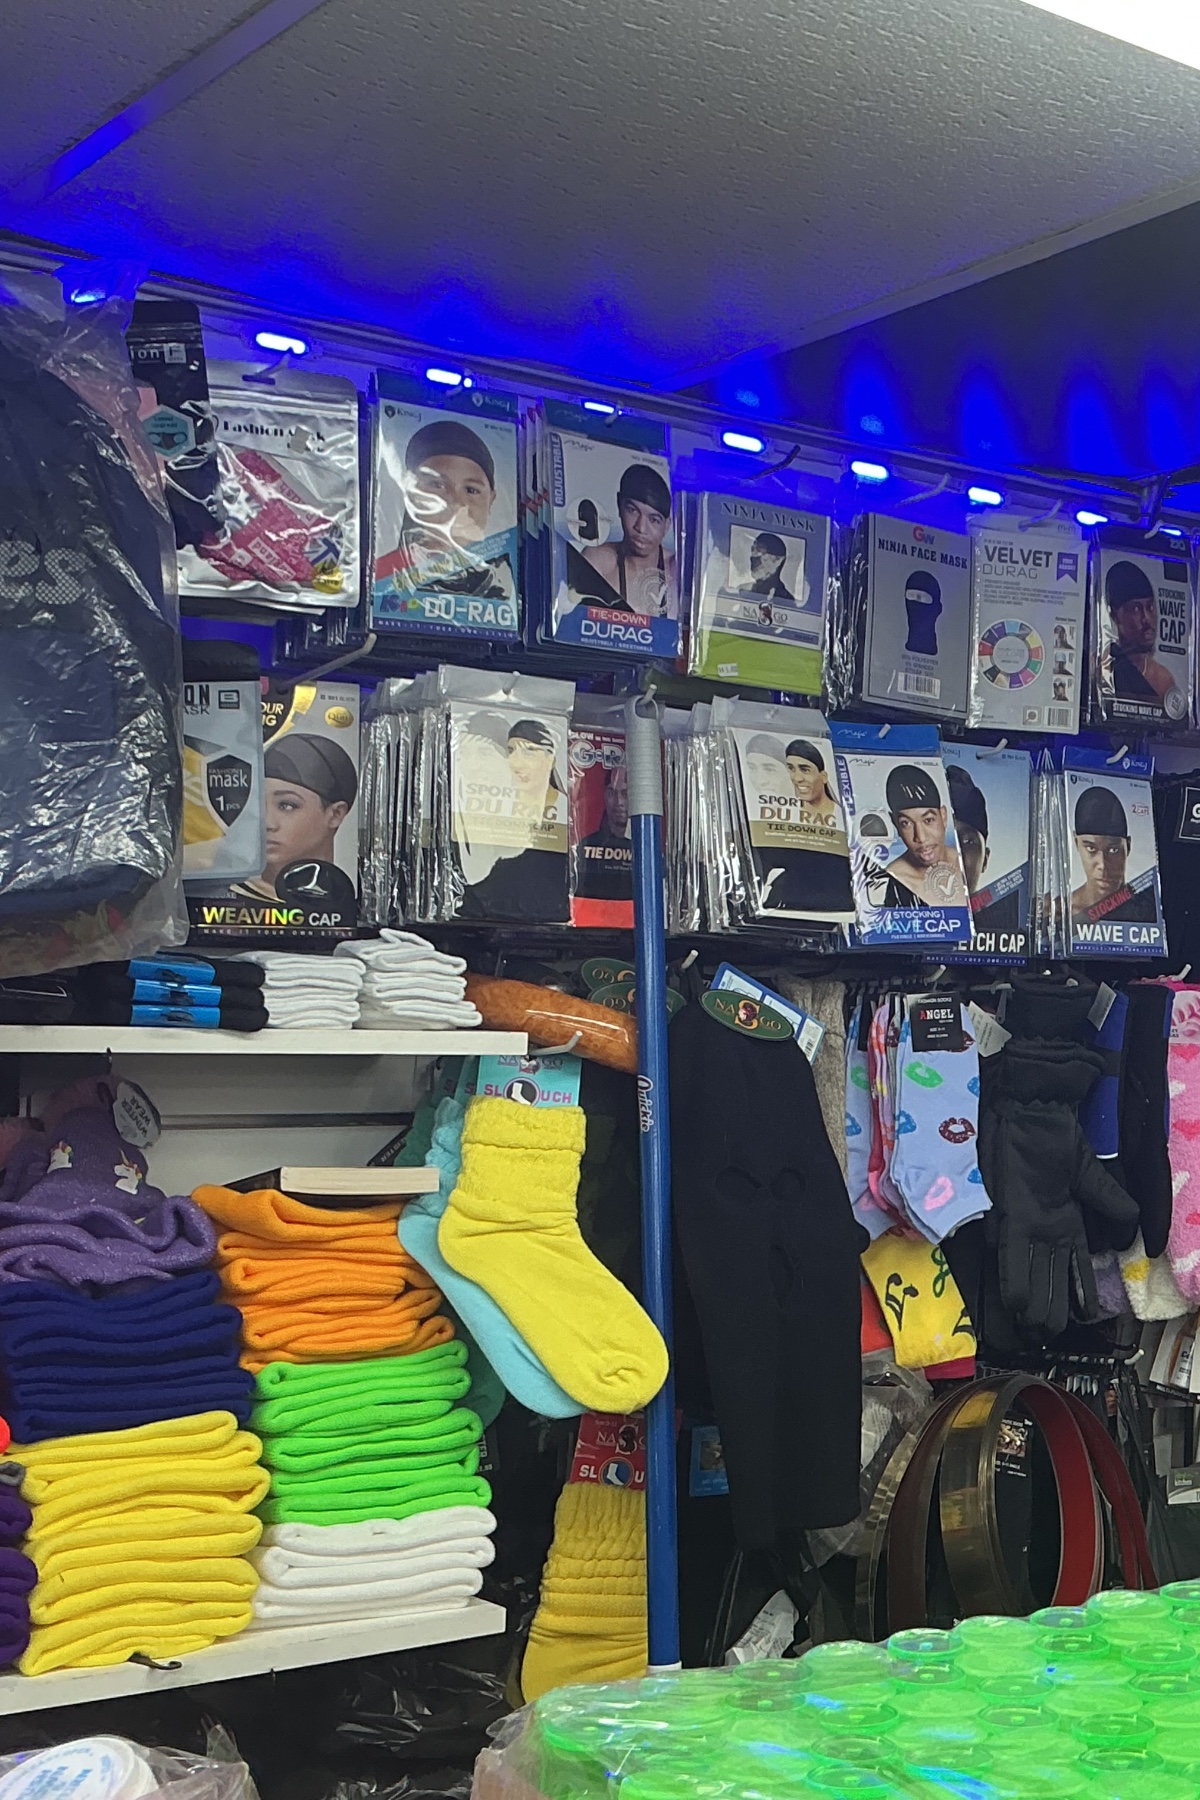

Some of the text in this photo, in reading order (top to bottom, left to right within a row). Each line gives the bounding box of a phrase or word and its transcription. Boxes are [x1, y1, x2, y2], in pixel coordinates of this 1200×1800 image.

[552, 434, 565, 506] ADJUSTABLE
[721, 502, 816, 533] NINJA MASK
[878, 538, 967, 570] NINJA FACE MASK
[984, 545, 1053, 569] VELVET
[982, 563, 1038, 579] DURAG
[1158, 588, 1186, 600] STOCKING
[424, 595, 513, 626] DU-RAG
[590, 608, 649, 626] TIE-DOWN
[1158, 599, 1186, 619] WAVE
[581, 619, 653, 644] DURAG
[1159, 618, 1186, 644] CAP
[210, 769, 249, 788] mask
[226, 802, 241, 812] pcs
[465, 796, 499, 814] DU
[758, 794, 805, 808] SPORT
[760, 806, 837, 828] DU RAG
[767, 823, 837, 838] TIE DOWN CAP
[584, 846, 633, 861] TIE DOW
[1087, 887, 1132, 921] STOCKING
[203, 906, 341, 926] WEAVING CAP
[875, 919, 961, 934] WAVE CAP
[1076, 923, 1160, 944] WAVE CAP
[999, 935, 1025, 952] CAP
[920, 1008, 954, 1020] ANGEL
[130, 1096, 151, 1127] WEAR
[636, 1074, 654, 1133] Quickie
[121, 1098, 147, 1138] WINTER
